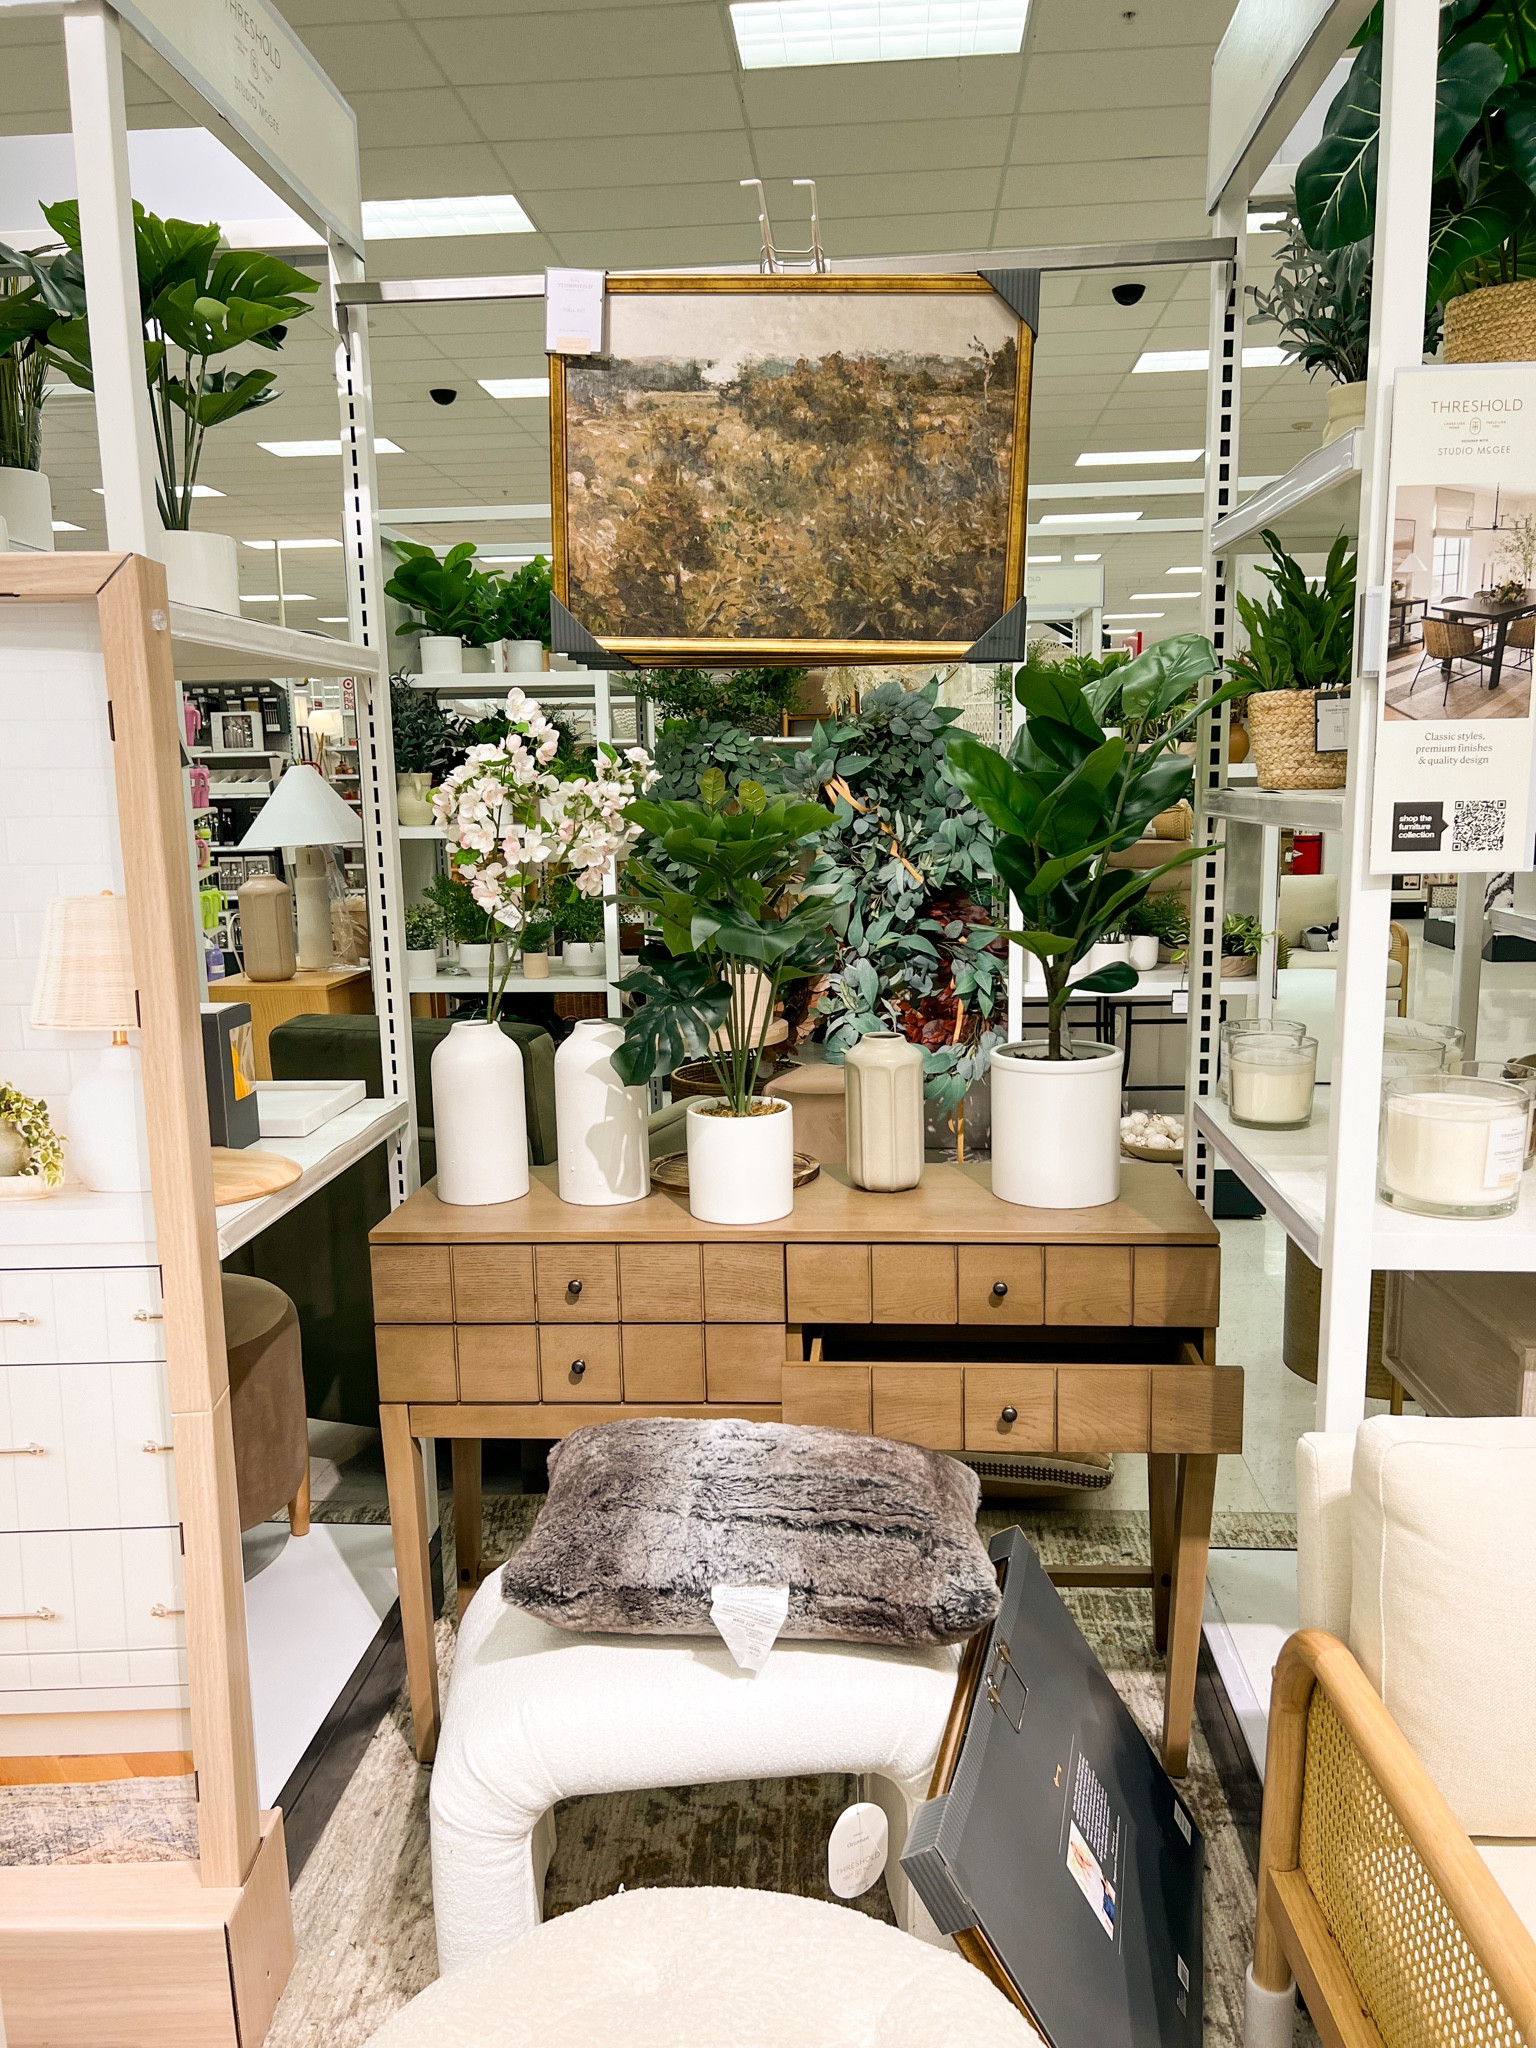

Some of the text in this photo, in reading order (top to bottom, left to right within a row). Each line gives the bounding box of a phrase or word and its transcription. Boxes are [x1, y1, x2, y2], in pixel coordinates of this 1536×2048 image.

[1431, 398, 1523, 414] THRESHOLD
[1437, 446, 1473, 456] STUDIO
[1424, 731, 1485, 742] Classic styles,
[1415, 743, 1493, 754] premium finishes
[1417, 755, 1489, 766] & quality design
[1399, 814, 1432, 823] shop the
[1398, 830, 1435, 838] collection
[836, 1850, 881, 1875] THRESHOLD
